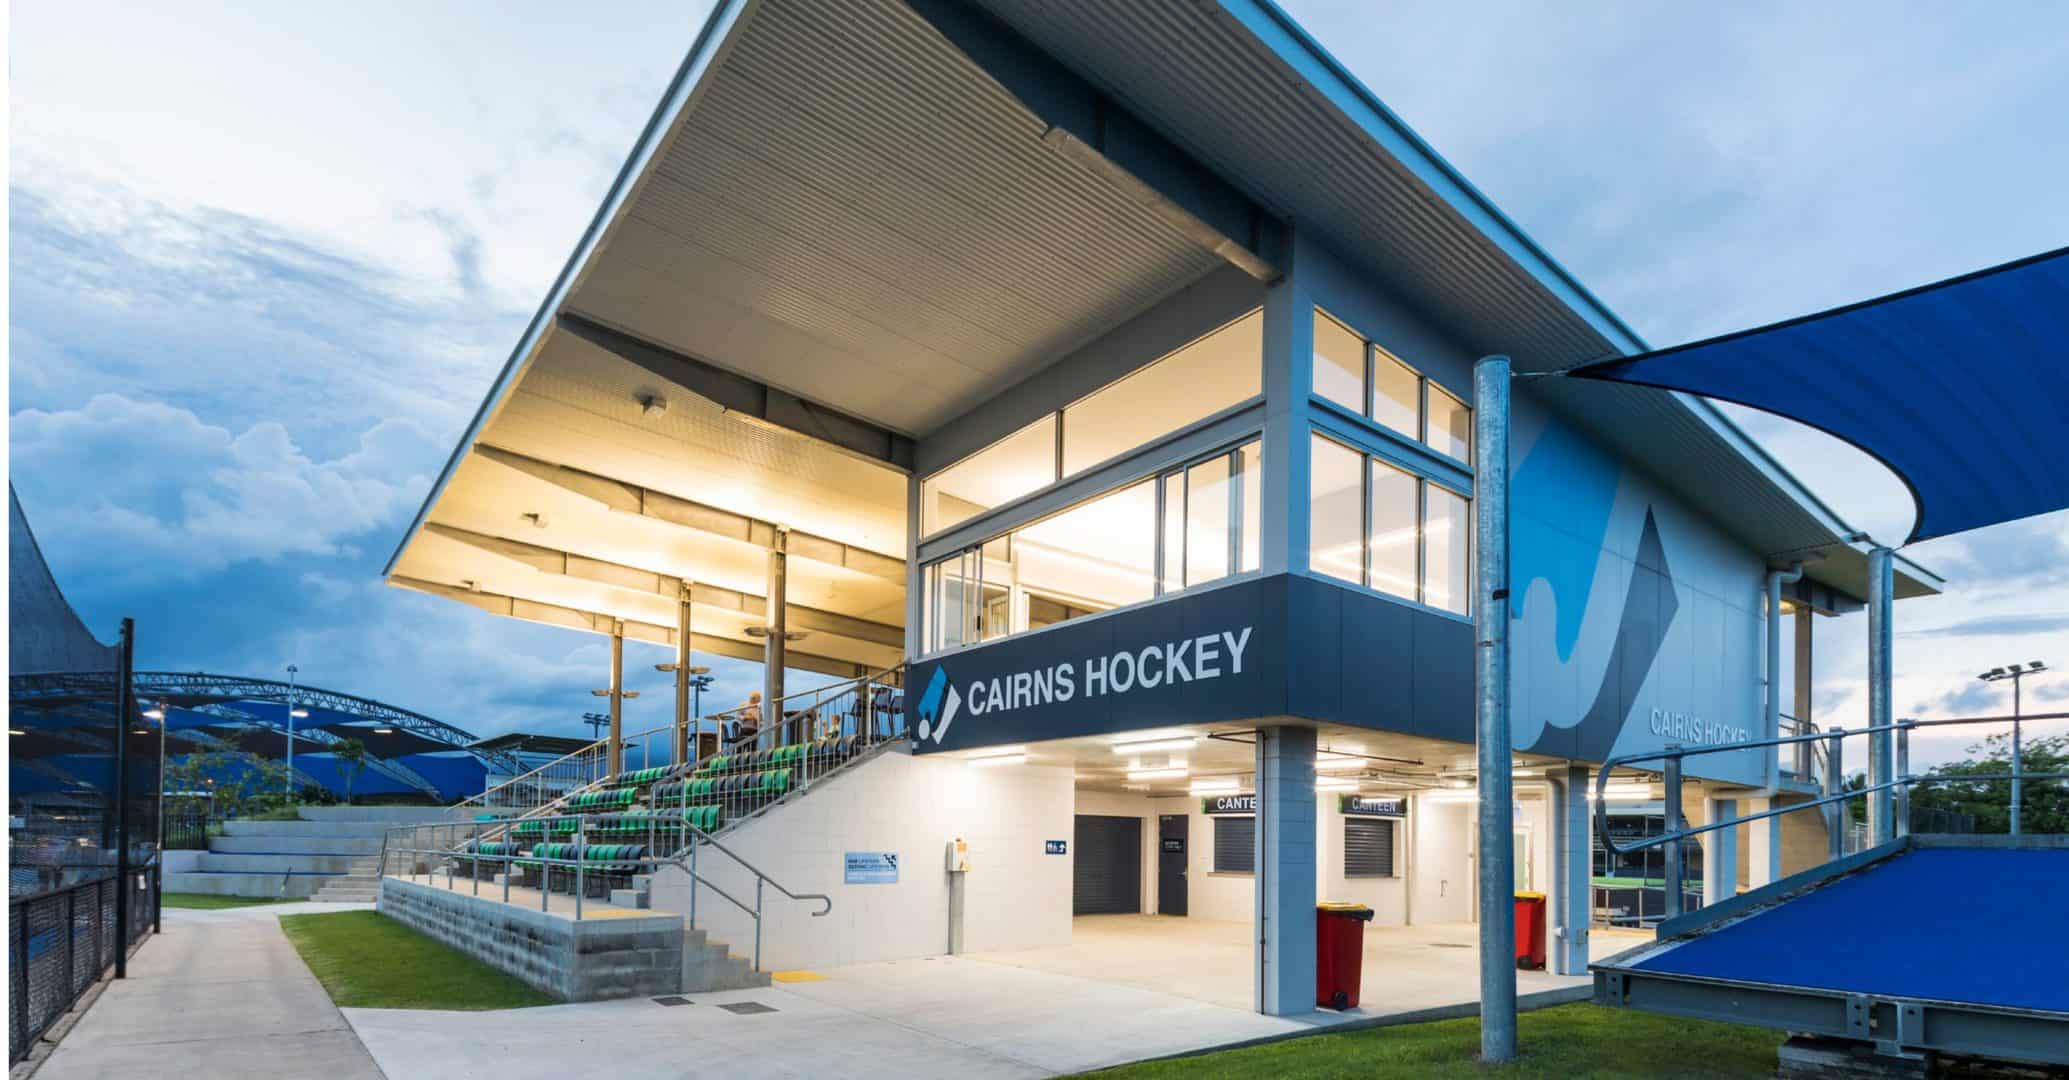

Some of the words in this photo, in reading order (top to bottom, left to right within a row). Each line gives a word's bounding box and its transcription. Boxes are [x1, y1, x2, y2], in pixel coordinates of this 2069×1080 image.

[967, 663, 1075, 716] CAIRNS
[1085, 627, 1253, 697] HOCKEY
[1650, 708, 1702, 743] CAIRNS
[1216, 797, 1256, 809] CANTE
